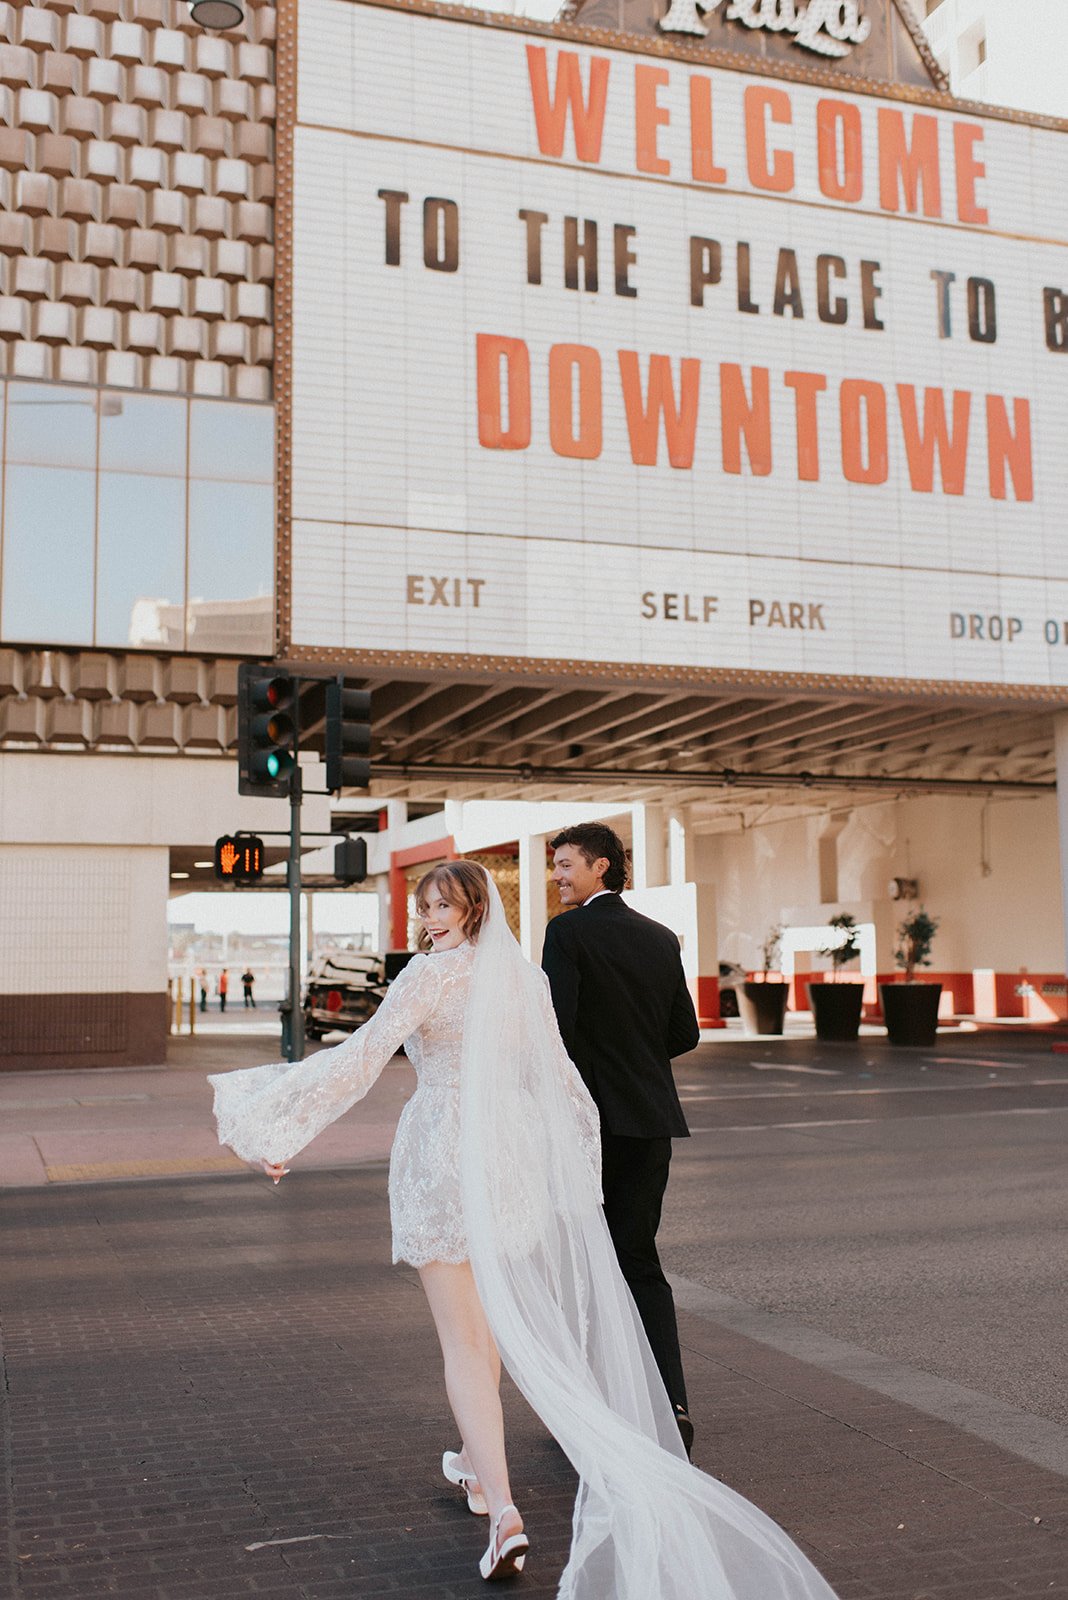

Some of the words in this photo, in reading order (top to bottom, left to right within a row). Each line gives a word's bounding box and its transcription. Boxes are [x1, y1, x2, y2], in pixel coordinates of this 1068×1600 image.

[525, 44, 989, 225] WELCOME
[377, 188, 459, 273] TO
[518, 208, 637, 298] THE
[689, 235, 885, 331] PLACE
[930, 269, 997, 344] TO
[476, 332, 1034, 503] DOWNTOWN
[406, 575, 486, 608] EXIT
[641, 591, 718, 623] SELF
[749, 600, 826, 630] PARK
[949, 612, 1023, 642] DROP
[245, 848, 259, 872] 11
